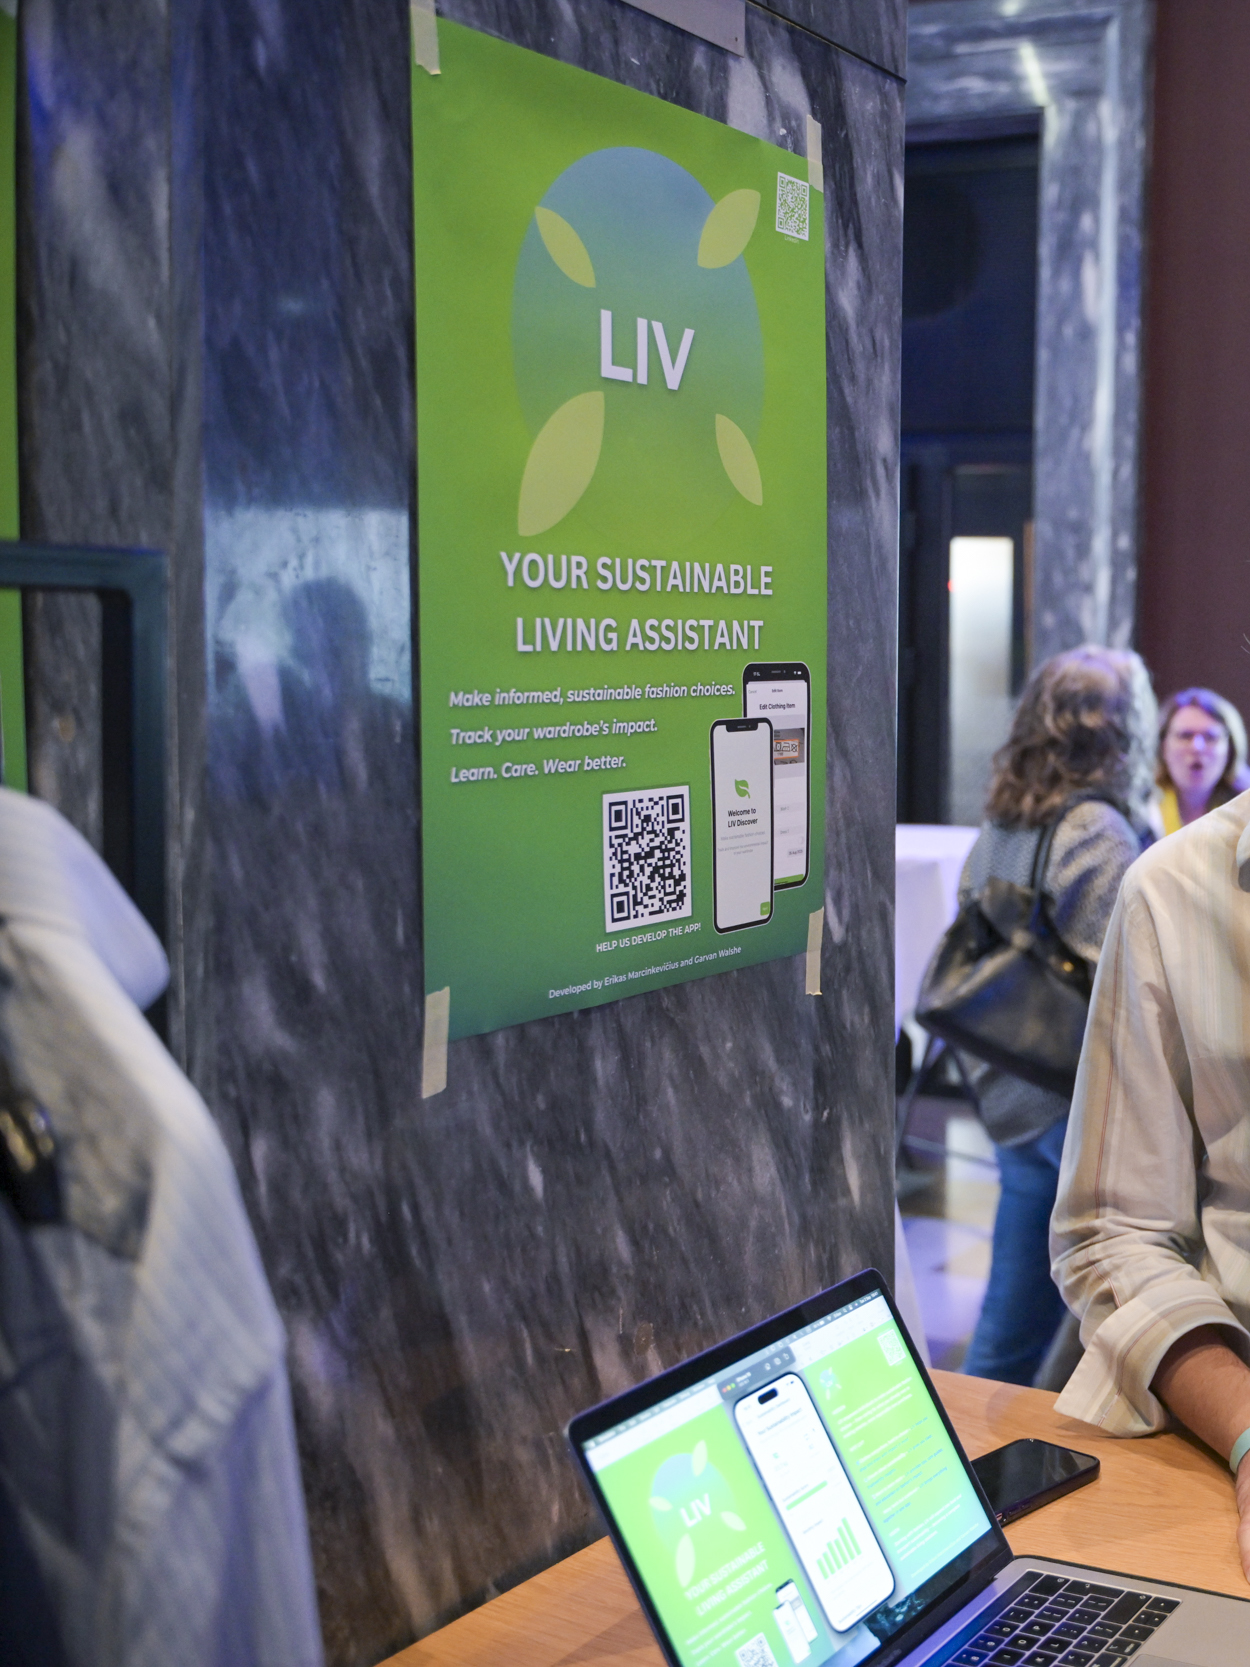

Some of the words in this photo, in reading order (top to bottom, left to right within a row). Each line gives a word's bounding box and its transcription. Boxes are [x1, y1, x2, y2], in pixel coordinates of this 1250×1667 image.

[600, 308, 695, 391] LIV
[500, 551, 589, 589] YOUR
[596, 557, 773, 595] SUSTAINABLE
[516, 617, 618, 652] LIVING
[625, 618, 764, 651] ASSISTANT
[449, 689, 491, 707] Make
[495, 686, 564, 706] informed,
[567, 684, 642, 702] sustainable
[645, 682, 687, 699] fashion
[690, 681, 735, 697] choices.
[450, 728, 492, 745] Track
[495, 726, 531, 745] your
[533, 720, 609, 741] wardrobe's
[611, 719, 658, 737] impact.
[451, 766, 497, 783] Learn.
[501, 762, 539, 778] Care.
[542, 758, 581, 774] Wear
[583, 755, 626, 771] better.
[728, 808, 749, 817] Welcome
[728, 820, 736, 828] LIV
[737, 818, 758, 827] Discover
[596, 940, 618, 953] HELP
[619, 938, 631, 948] US
[631, 930, 667, 945] DEVELOP
[668, 926, 683, 937] THE
[684, 922, 702, 934] APP!
[548, 982, 592, 999] Developed
[593, 978, 603, 989] by
[604, 972, 627, 986] Erikas
[680, 957, 693, 967] and
[694, 951, 717, 964] Garvan
[718, 946, 742, 958] Walshe
[680, 1493, 712, 1528] LIV
[684, 1577, 712, 1601] YOUR
[709, 1541, 766, 1585] SUSTAINABLE
[695, 1589, 727, 1617] LIVING
[725, 1559, 769, 1596] ASSISTANT
